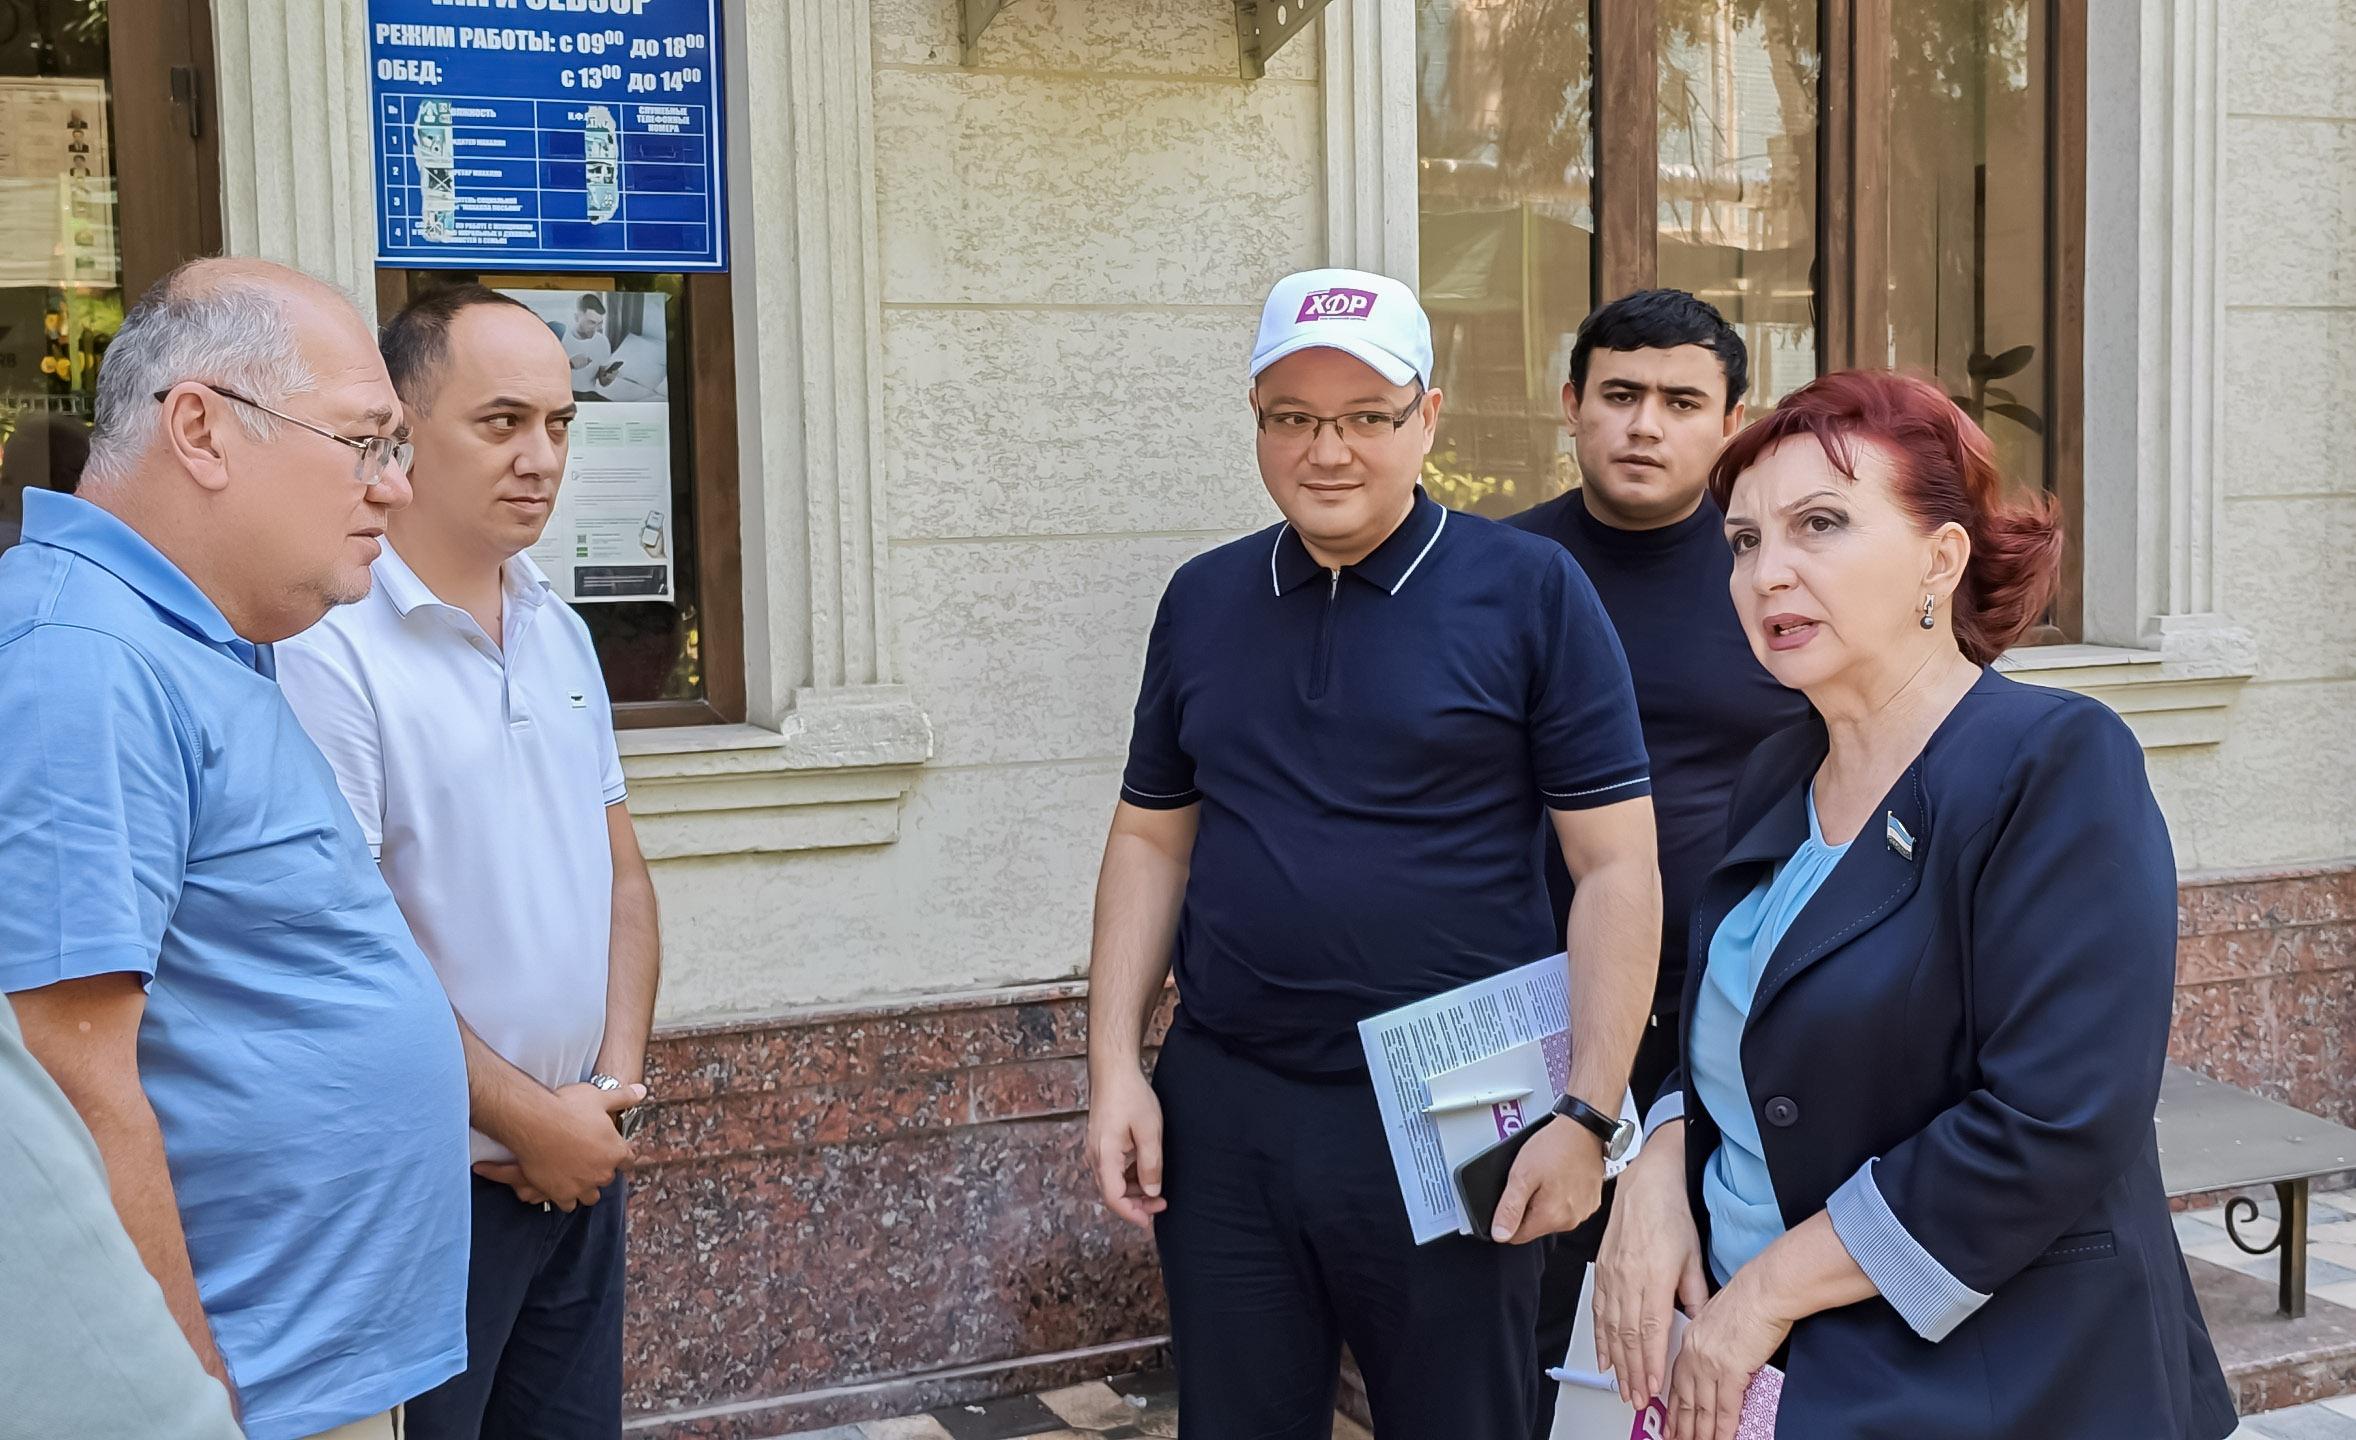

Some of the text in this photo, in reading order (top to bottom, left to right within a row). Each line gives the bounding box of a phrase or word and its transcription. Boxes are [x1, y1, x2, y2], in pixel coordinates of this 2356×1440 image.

[376, 23, 455, 48] РЕЖИМ
[460, 27, 556, 52] РАБОТЫ:
[629, 38, 660, 59] до
[377, 59, 443, 85] ОБЕД:
[627, 73, 657, 93] до
[392, 167, 399, 176] 2
[394, 228, 401, 237] 4
[1305, 294, 1368, 315] XDP
